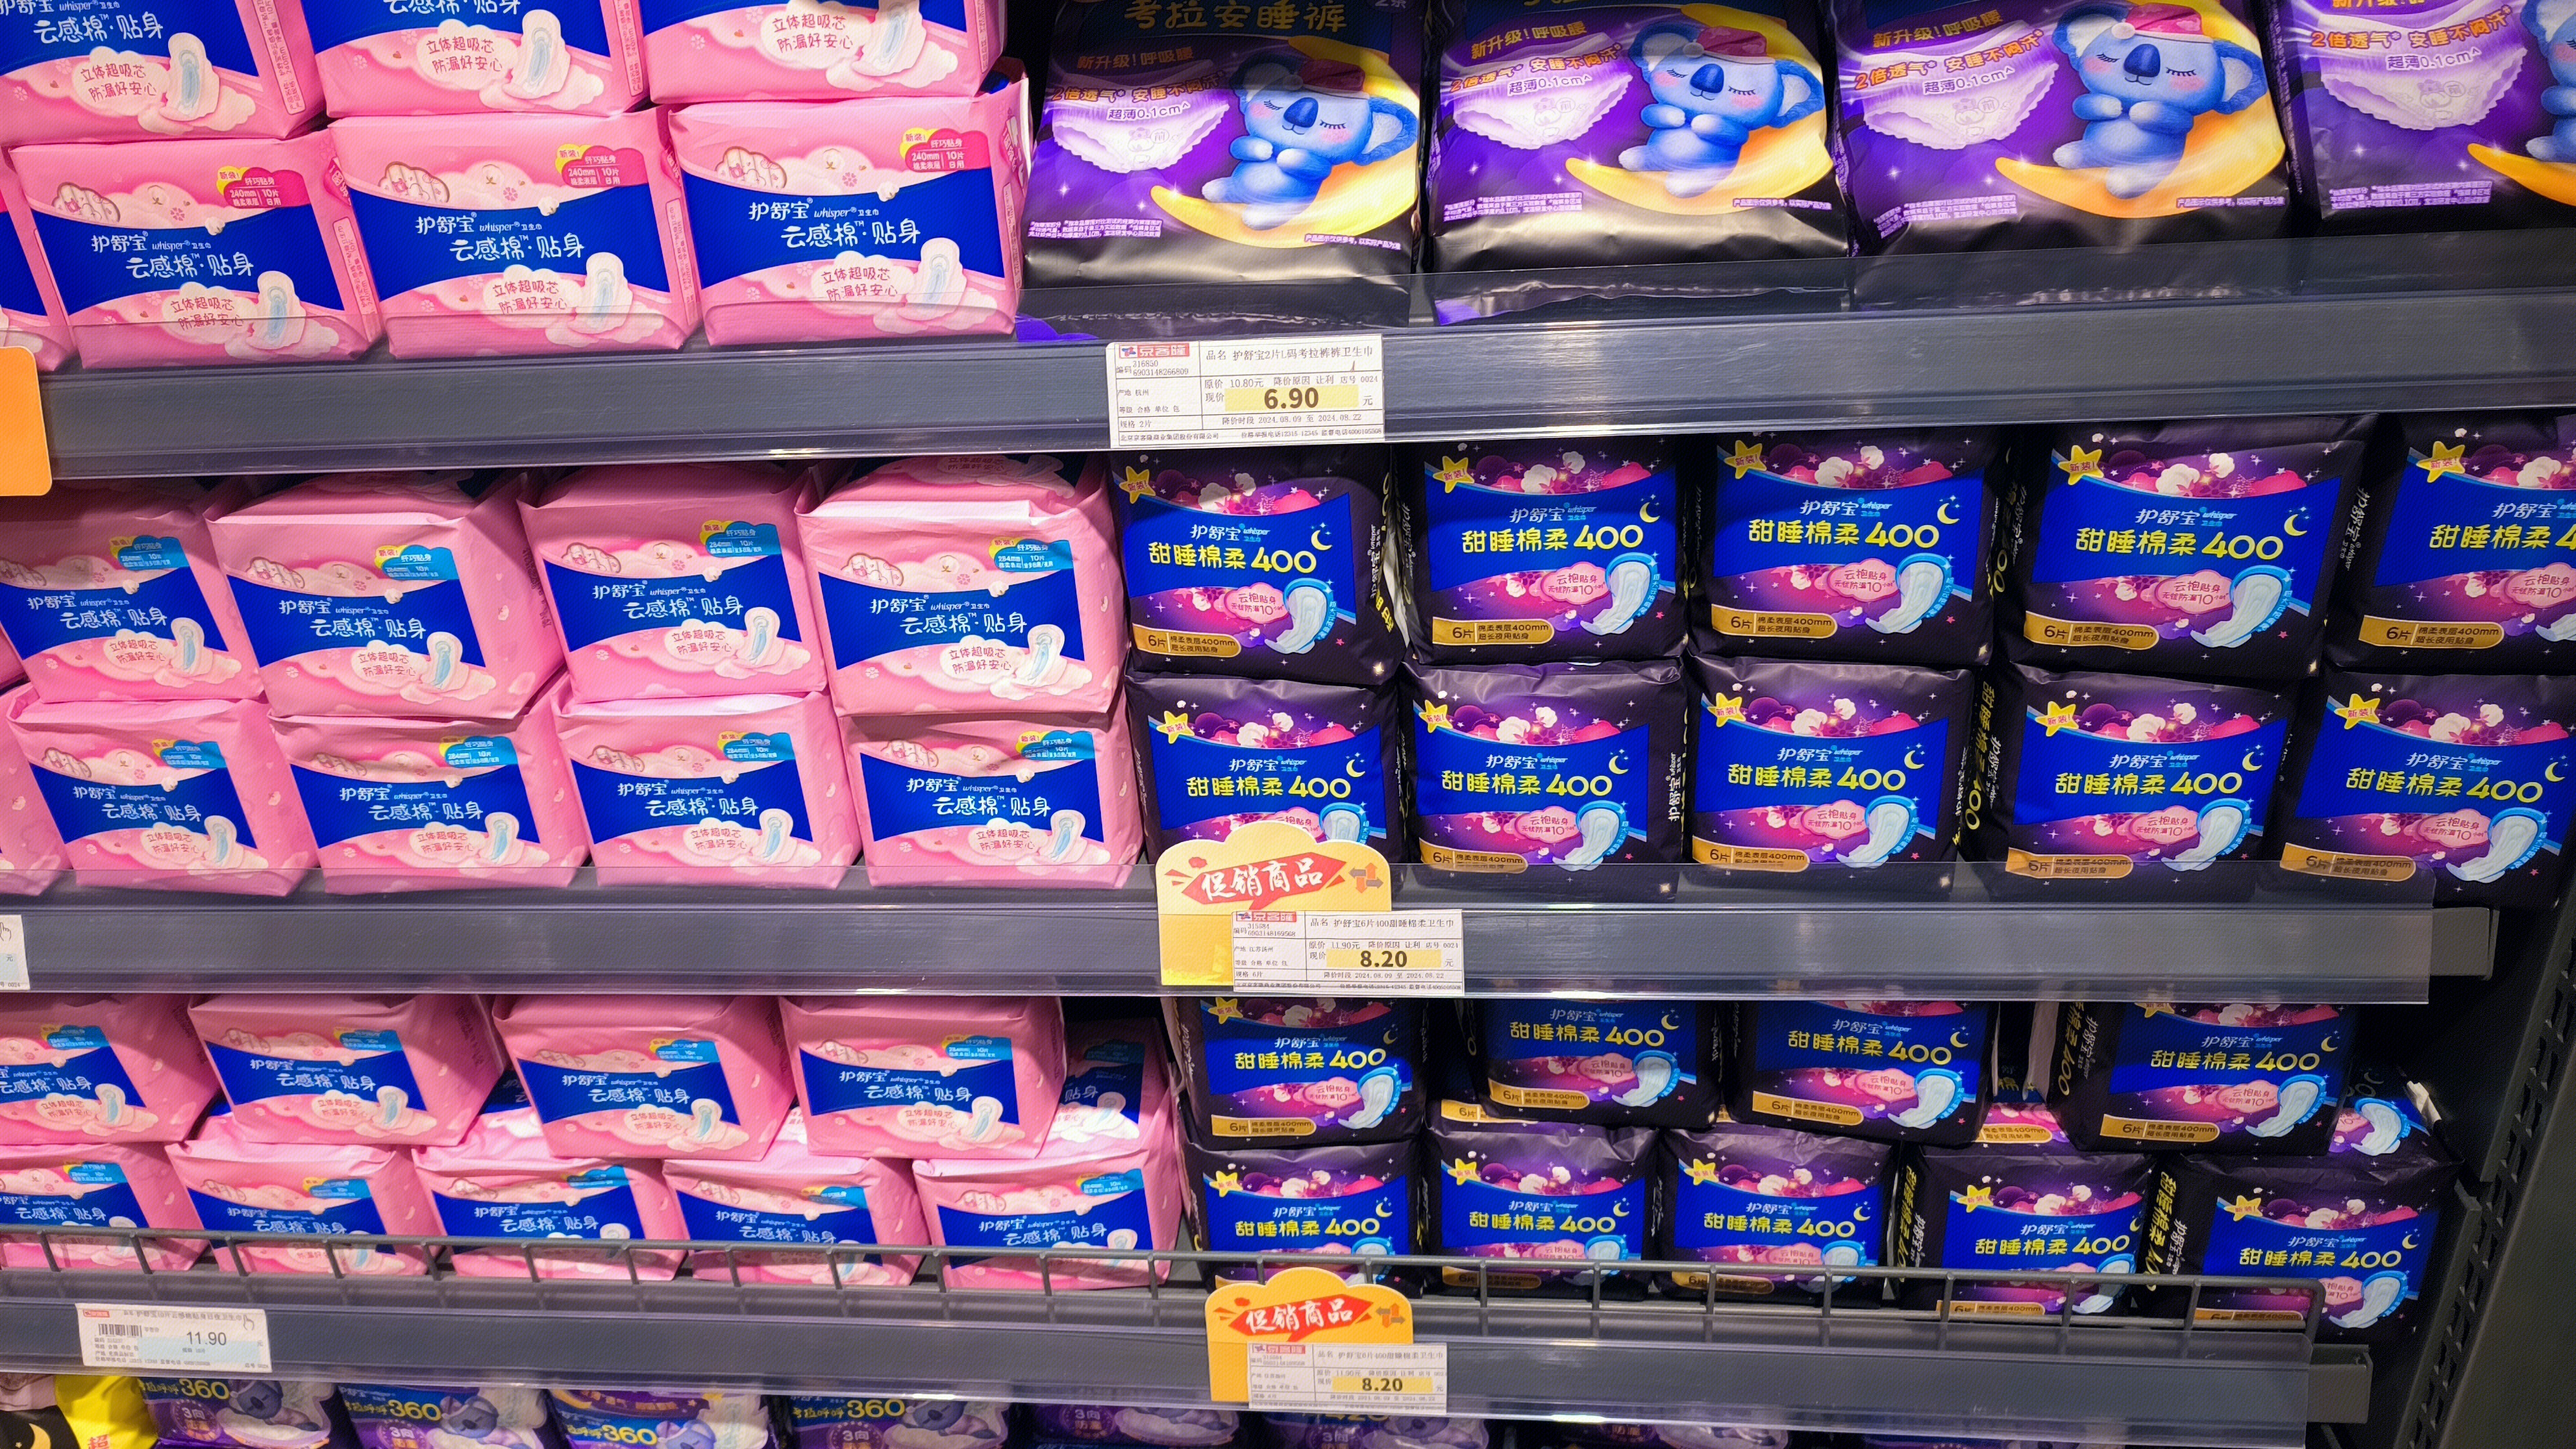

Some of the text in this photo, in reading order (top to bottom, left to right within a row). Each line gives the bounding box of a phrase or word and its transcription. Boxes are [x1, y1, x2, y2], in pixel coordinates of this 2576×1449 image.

[772, 14, 846, 33] 立体超吸芯
[1124, 0, 1347, 32] 考拉安睡裤
[426, 36, 495, 55] 立体超吸芯
[776, 34, 854, 53] 防漏好安心
[80, 64, 147, 79] 立体超吸芯
[432, 56, 502, 73] 防漏好安心
[88, 82, 158, 102] 防漏好安心
[748, 201, 810, 221] 护舒宝
[415, 215, 475, 234] 护舒宝
[91, 233, 147, 253] 护舒宝
[821, 267, 891, 284] 立体超吸芯
[493, 280, 560, 297] 立体超吸芯
[826, 284, 898, 302] 防漏好安心
[170, 299, 235, 314] 立体超吸芯
[499, 297, 568, 314] 防漏好安心
[178, 313, 245, 331] 防漏好安心
[1206, 350, 1226, 360] 品名
[1204, 379, 1223, 389] 原价
[1230, 378, 1264, 388] 10.80元
[1274, 377, 1310, 386] 降价原因
[1316, 375, 1334, 384] 让利
[1206, 388, 1373, 409] 现价 6.90 元
[1509, 508, 1565, 523] 护舒宝
[1800, 500, 1859, 517] 护舒宝
[2135, 509, 2201, 526] 护舒宝
[2492, 502, 2558, 519] 护舒宝
[1190, 525, 1241, 542] 护舒宝
[1462, 525, 1643, 553] 甜睡棉柔400
[1748, 519, 1940, 549] 甜睡棉柔400
[2076, 528, 2284, 560] 甜睡棉柔400
[1148, 543, 1317, 574] 甜睡棉柔400
[592, 583, 646, 599] 护舒宝
[279, 601, 331, 615] 护舒宝
[870, 597, 927, 614] 护舒宝
[672, 630, 726, 642] 立体超吸芯
[1453, 627, 1474, 639] 6片
[2044, 626, 2068, 640] 6片
[2386, 626, 2412, 641] 6片
[948, 646, 1006, 660] 立体超吸芯
[952, 660, 1012, 674] 防漏好安心
[1485, 754, 1538, 770] 护舒宝
[1777, 748, 1831, 763] 护舒宝
[2109, 754, 2168, 769] 护舒宝
[2406, 753, 2468, 771] 护舒宝
[1229, 758, 1279, 773] 护舒宝
[906, 778, 958, 793] 护舒宝
[1442, 770, 1613, 797] 甜睡棉柔400
[1728, 763, 1905, 791] 甜睡棉柔400
[2055, 772, 2242, 795] 甜睡棉柔400
[2346, 768, 2543, 803] 甜睡棉柔400
[1186, 775, 1351, 799] 甜睡棉柔400
[1202, 857, 1324, 901] 促销商品
[1360, 950, 1407, 967] 8.20
[1445, 959, 1454, 967] 元
[1510, 1021, 1665, 1046] 甜睡棉柔400
[1832, 1019, 1883, 1036] 护舒宝
[1789, 1030, 1951, 1065] 甜睡棉柔400
[1235, 1048, 1387, 1070] 甜睡棉柔400
[2150, 1050, 2321, 1072] 甜睡棉柔400
[1771, 1101, 1790, 1112] 6片
[1235, 1218, 1380, 1237] 甜睡棉柔400
[1469, 1211, 1616, 1233] 甜睡棉柔400
[1704, 1213, 1856, 1237] 甜睡棉柔400
[1975, 1235, 2130, 1256] 甜睡棉柔400
[2240, 1248, 2402, 1269] 甜睡棉柔400
[1246, 1298, 1353, 1334] 促销商品
[186, 1331, 227, 1345] 11.90
[179, 1378, 230, 1400] 360
[1363, 1378, 1403, 1391] 8.20
[388, 1399, 442, 1422] 360
[847, 1399, 905, 1419] 360
[601, 1424, 658, 1446] 360
